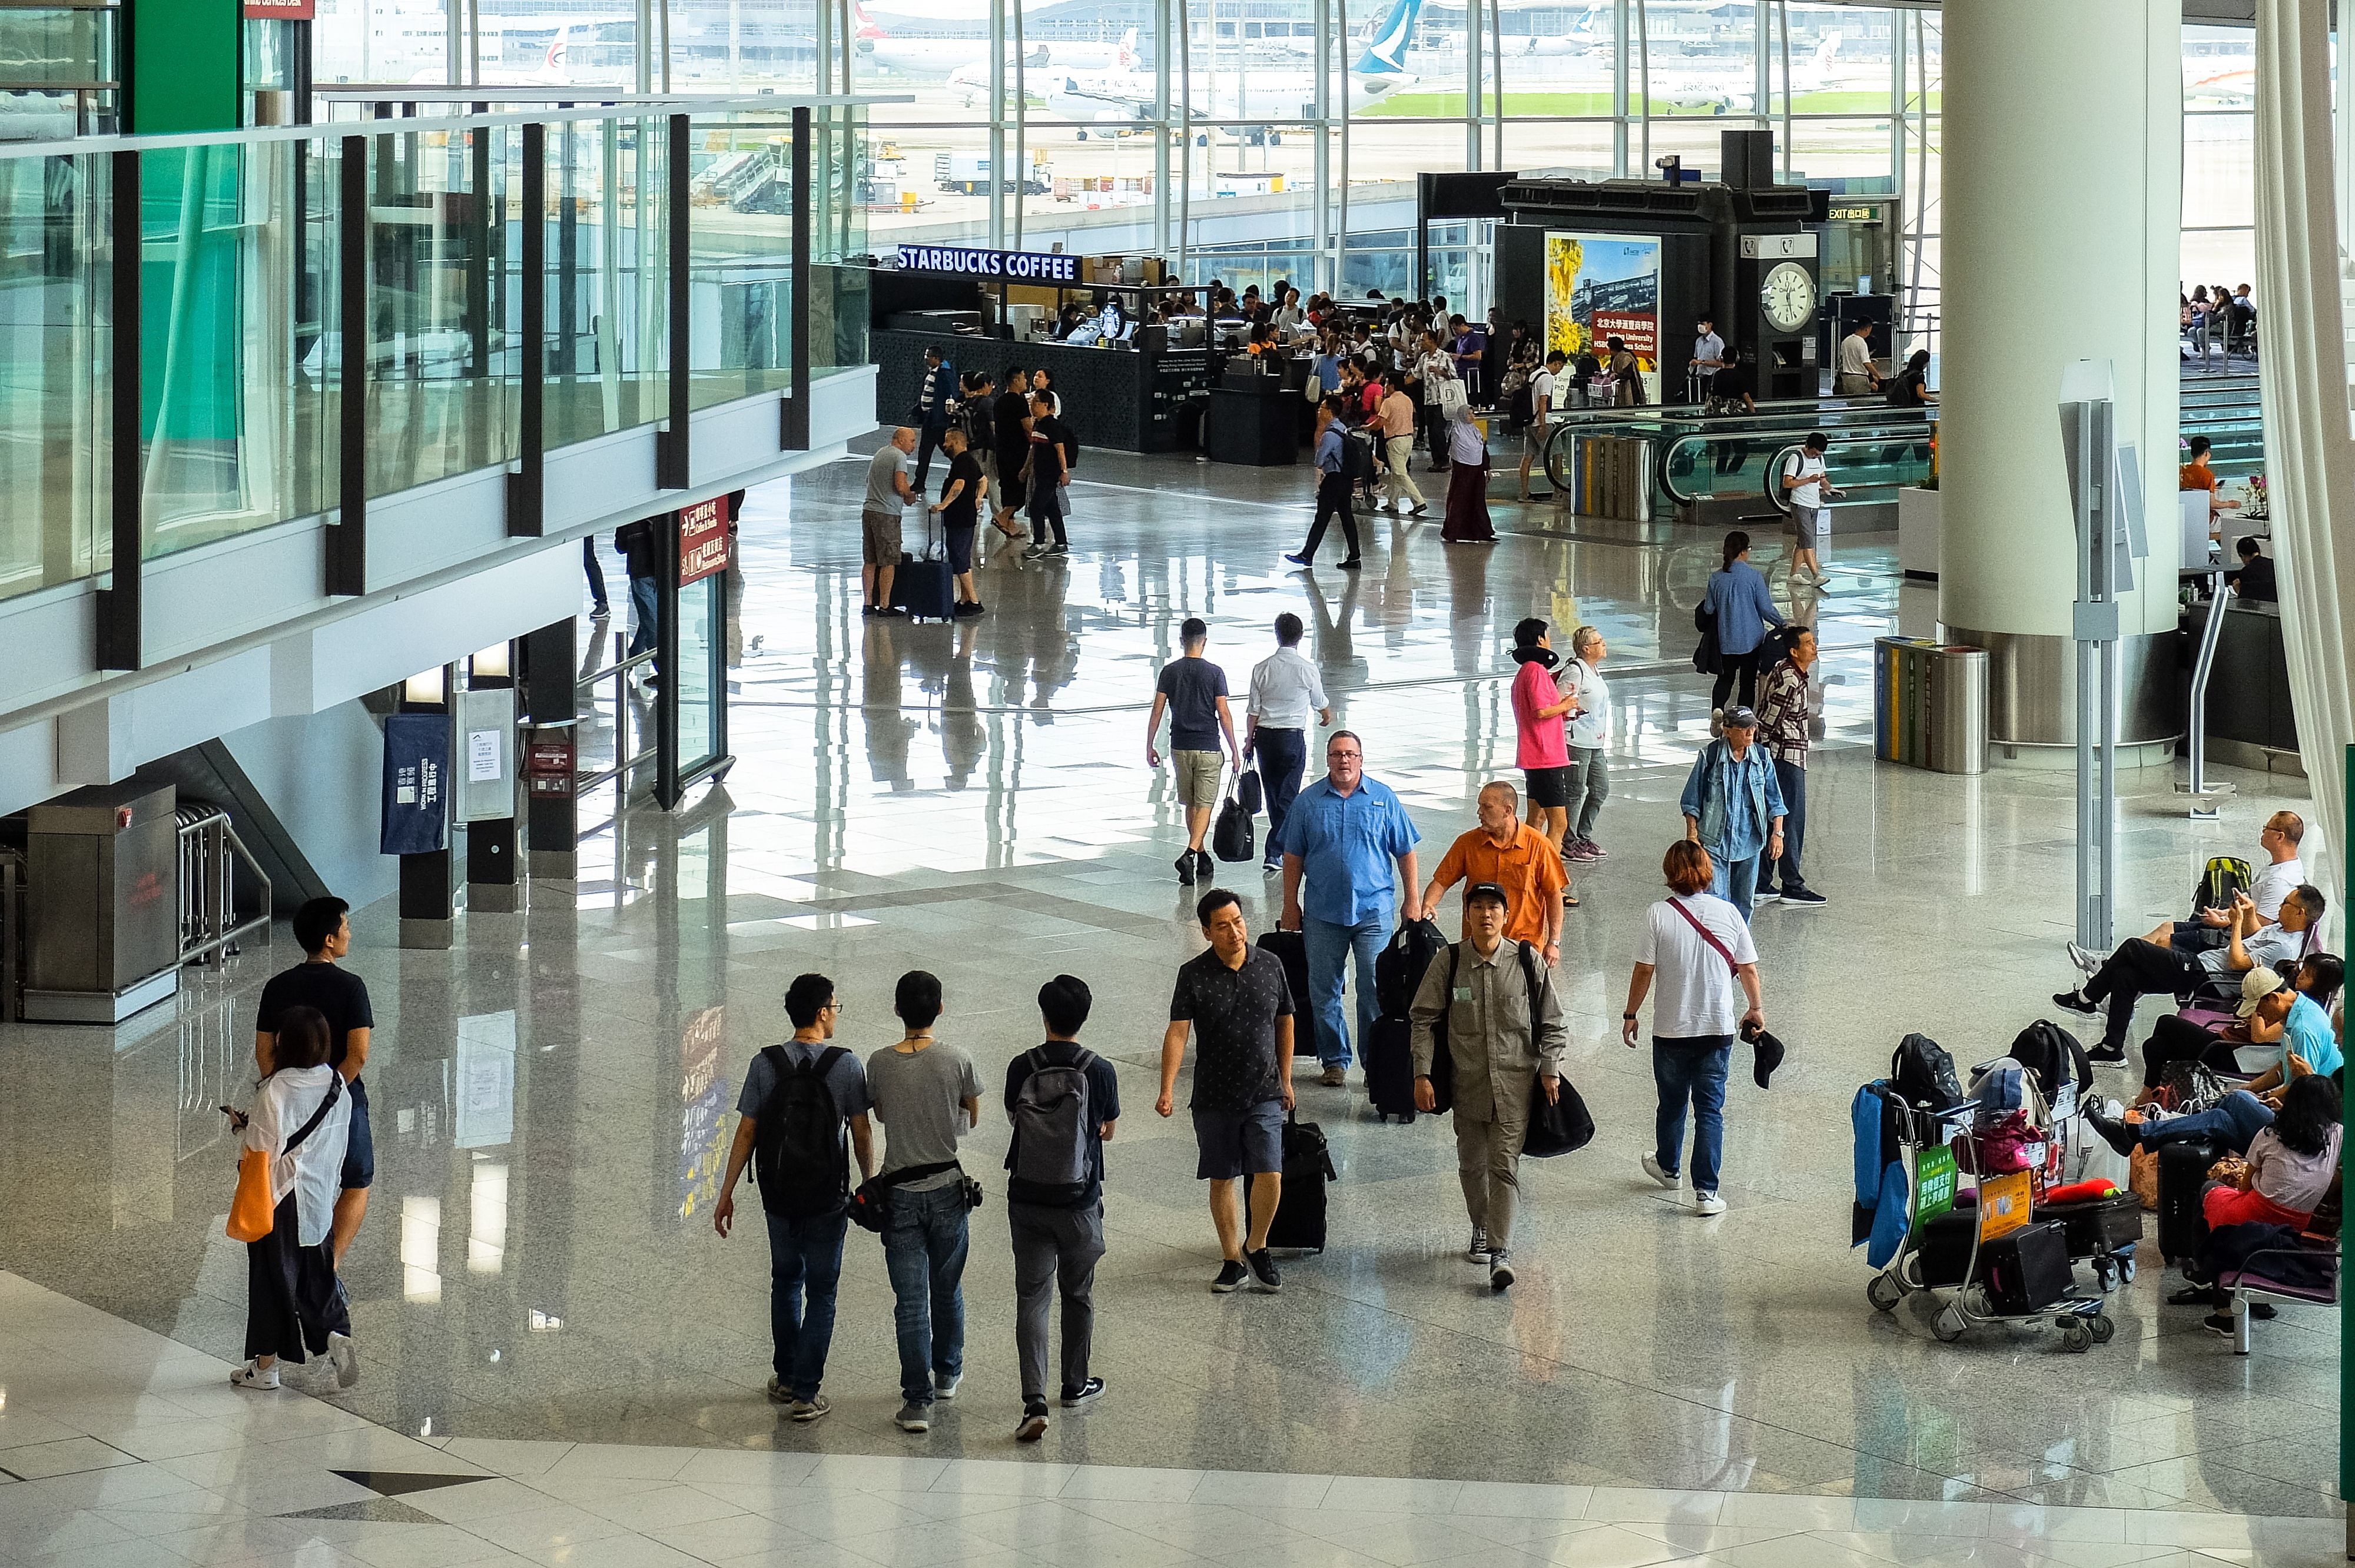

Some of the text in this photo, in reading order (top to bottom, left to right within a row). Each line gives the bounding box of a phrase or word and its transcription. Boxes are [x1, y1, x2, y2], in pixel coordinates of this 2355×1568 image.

[1829, 209, 1847, 219] EXIT
[1847, 209, 1862, 218] 出口
[898, 248, 1074, 280] STARBUCKS COFFEE
[1626, 333, 1653, 343] University
[1634, 343, 1653, 351] School
